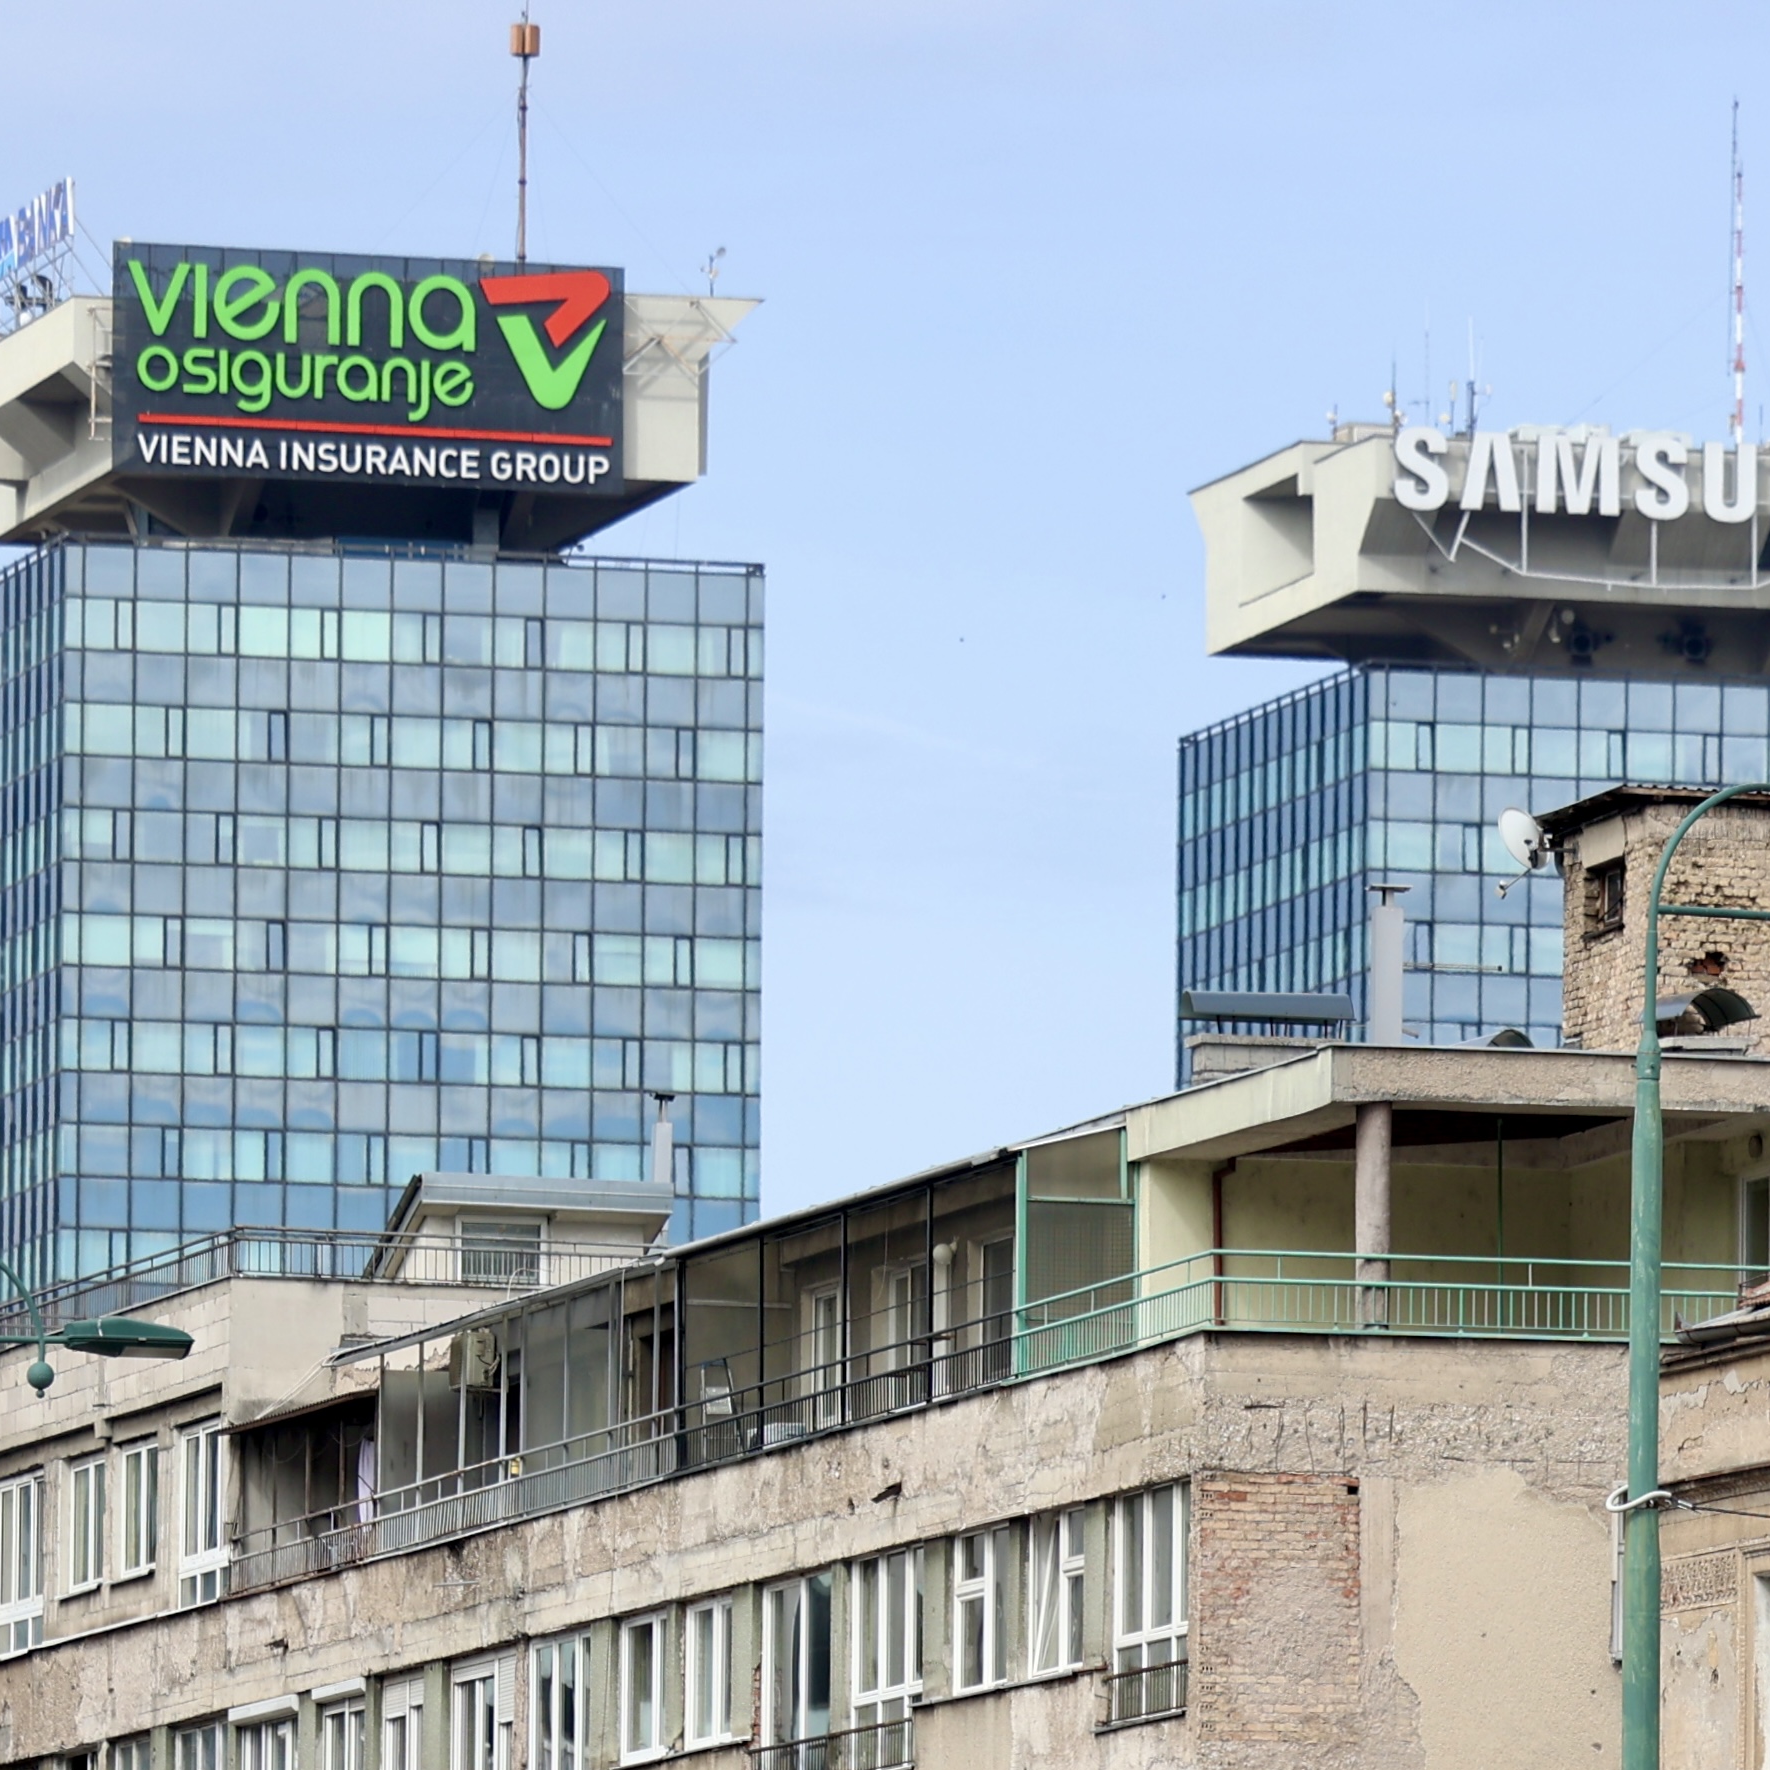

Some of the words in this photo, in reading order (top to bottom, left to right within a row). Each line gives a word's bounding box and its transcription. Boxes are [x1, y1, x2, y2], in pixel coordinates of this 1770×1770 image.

[18, 175, 75, 270] BANKA
[136, 345, 475, 422] osiguranje
[137, 432, 269, 471] VIENNA
[278, 441, 482, 480] INSURANCE
[488, 449, 611, 485] GROUP
